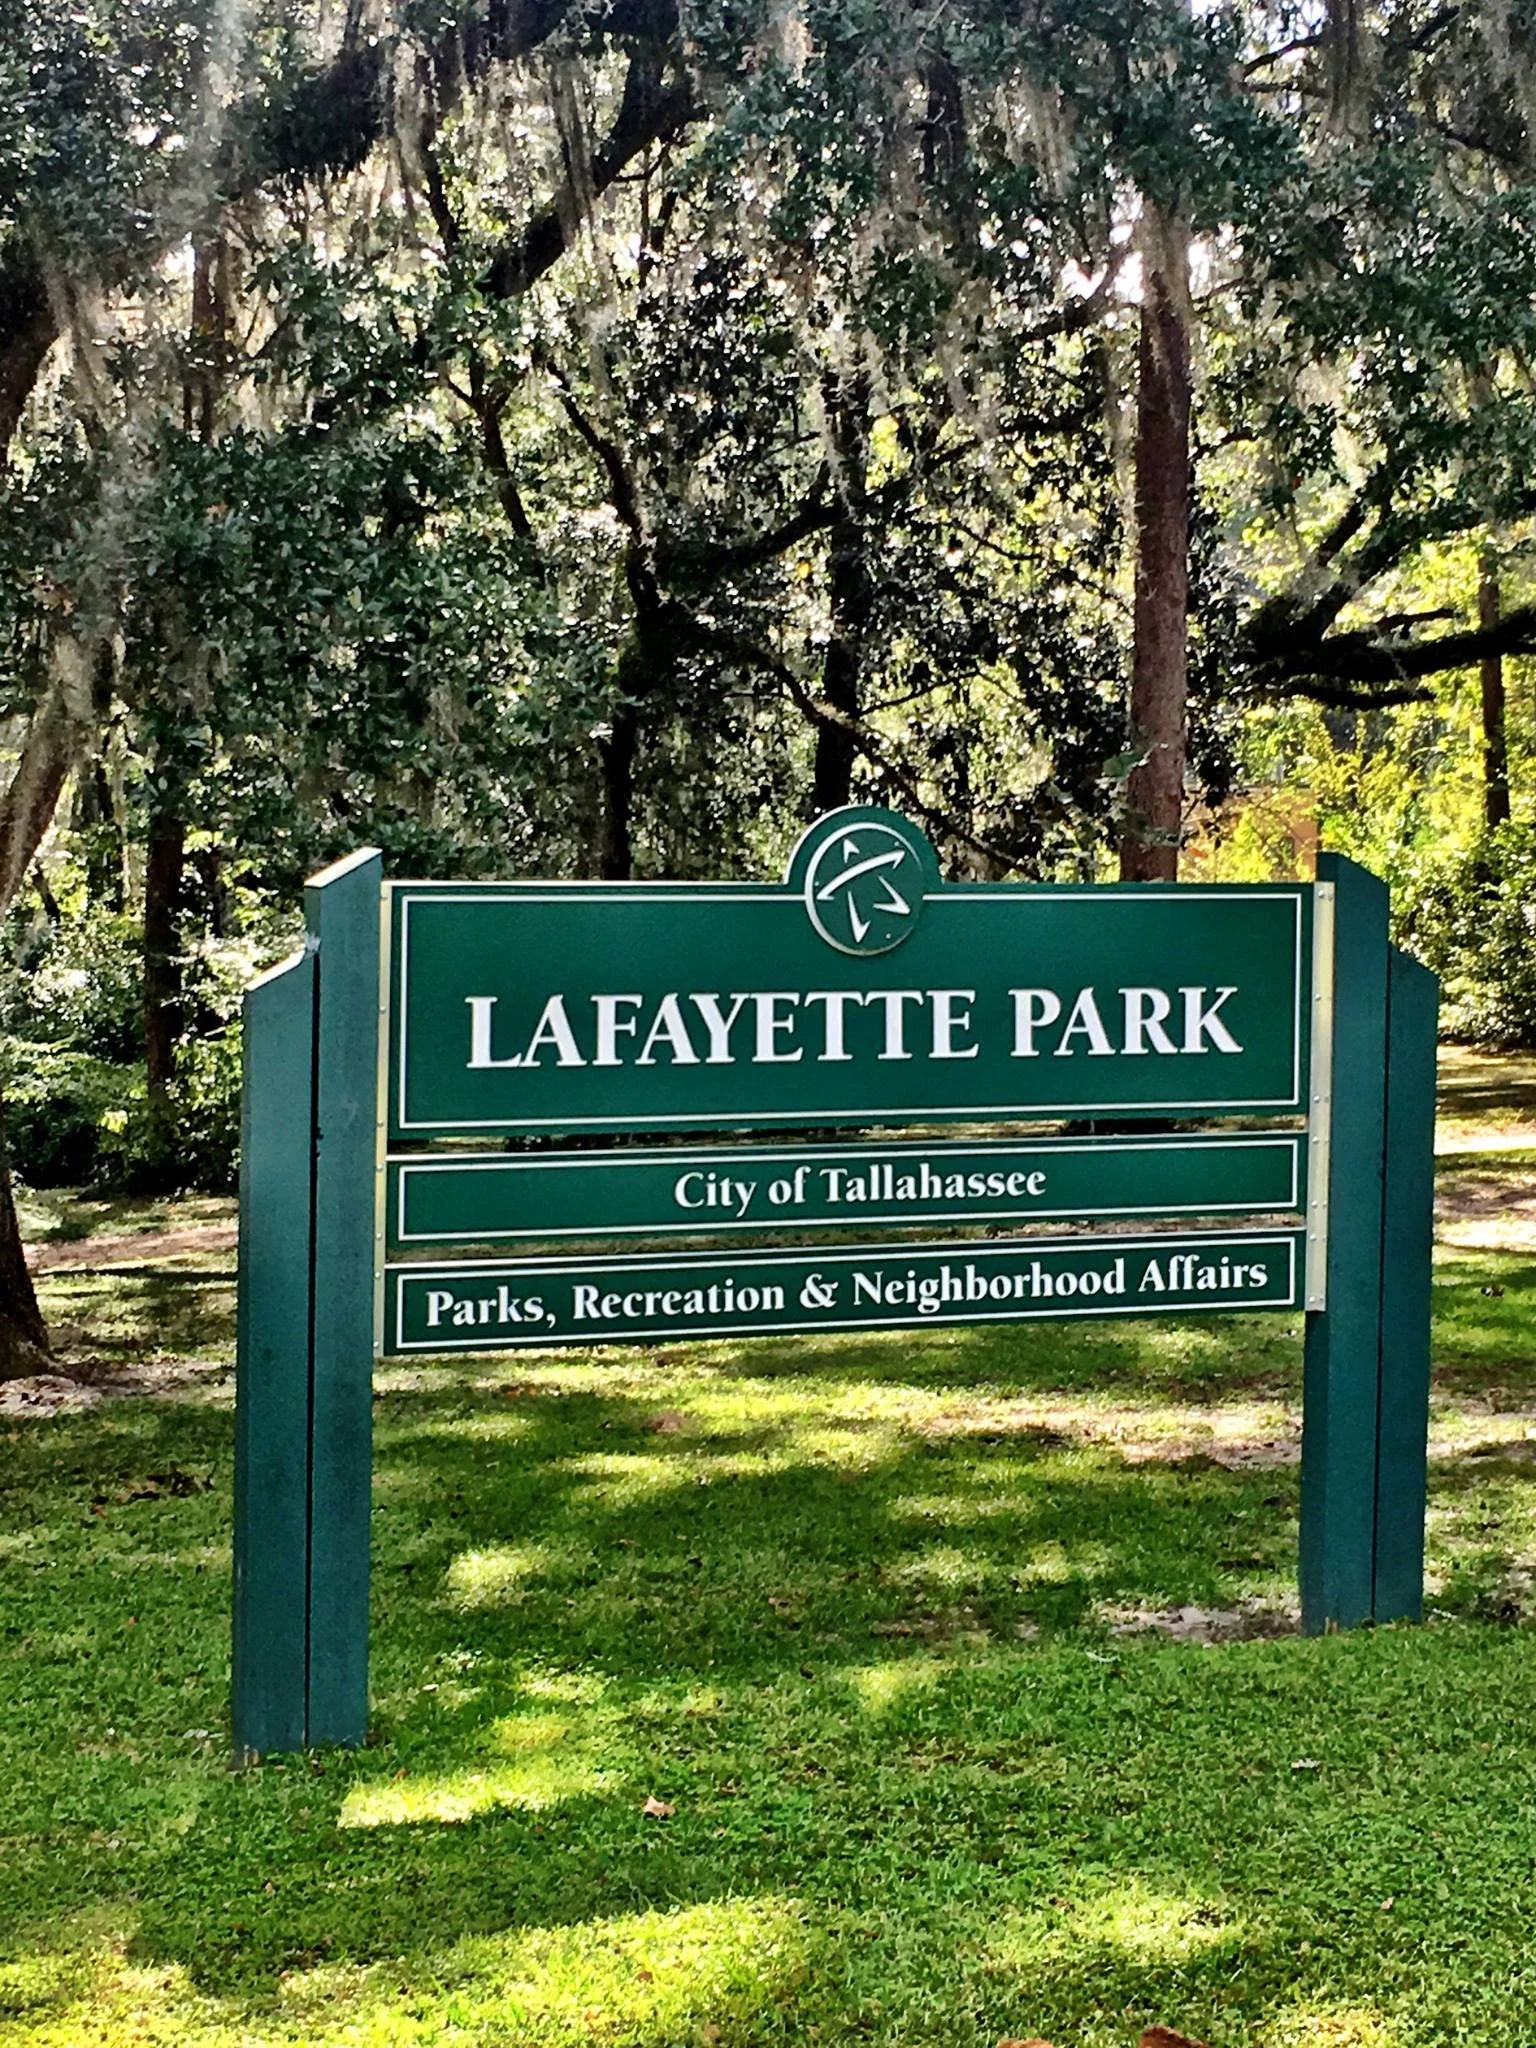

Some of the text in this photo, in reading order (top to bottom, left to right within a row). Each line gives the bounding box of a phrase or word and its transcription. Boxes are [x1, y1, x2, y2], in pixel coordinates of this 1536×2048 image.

[465, 986, 1244, 1068] LAFAYETTE PARK
[675, 1163, 1046, 1217] City of Tallahassee
[426, 1254, 1268, 1328] Parks, Recreation & Neighborhood Affairs
